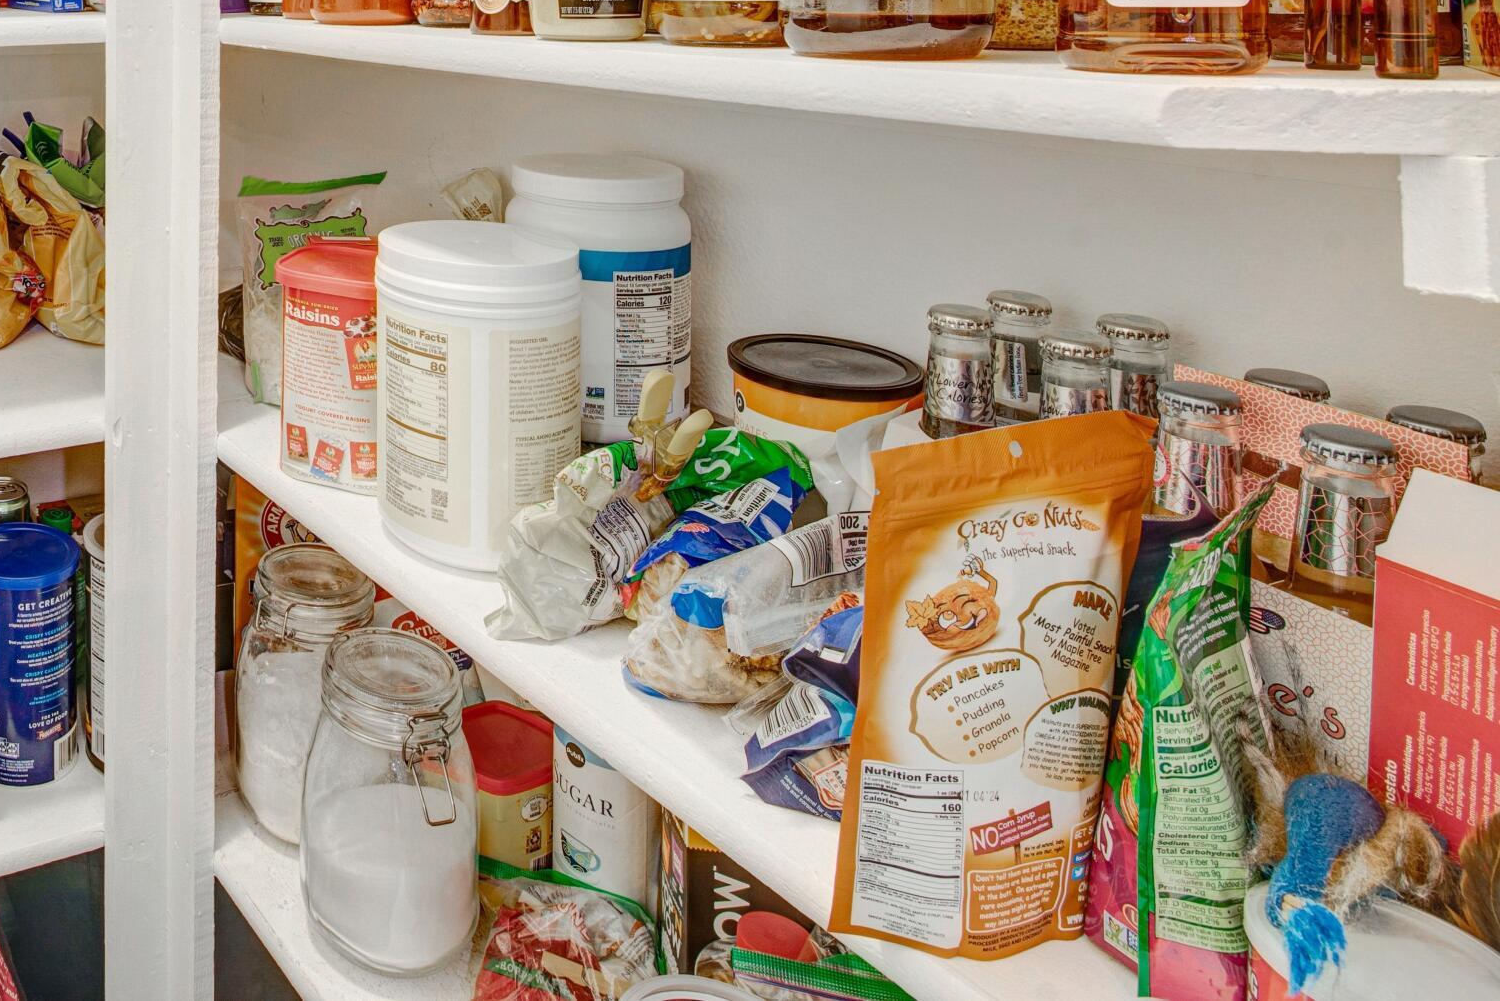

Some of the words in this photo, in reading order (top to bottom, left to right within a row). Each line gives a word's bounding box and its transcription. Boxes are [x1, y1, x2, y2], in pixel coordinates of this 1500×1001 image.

[285, 301, 340, 327] Raisins
[957, 519, 1008, 542] Crazy
[1044, 506, 1083, 530] Nuts
[982, 548, 998, 561] The
[1001, 543, 1044, 561] Superfood
[18, 602, 36, 612] GET
[38, 588, 73, 609] CREATIVE
[1073, 590, 1113, 622] MAPLE
[1064, 627, 1093, 646] Painful
[1073, 617, 1097, 636] Voted
[1044, 632, 1055, 646] by
[1058, 639, 1085, 658] Maple
[1086, 649, 1103, 664] Tree
[1051, 650, 1090, 673] Magazine
[925, 675, 953, 701] TRY
[956, 665, 980, 684] ME
[983, 658, 1021, 676] WITH
[953, 679, 1005, 706] Pancakes
[962, 698, 1006, 723] Pudding
[971, 712, 1012, 738] Granola
[978, 727, 1020, 754] Popcorn
[863, 765, 920, 780] Nutrition
[924, 772, 960, 784] Facts
[1159, 757, 1218, 776] Calories
[554, 759, 614, 818] SUGAR
[863, 793, 900, 807] Calories
[941, 803, 962, 813] 160
[971, 826, 999, 851] NO
